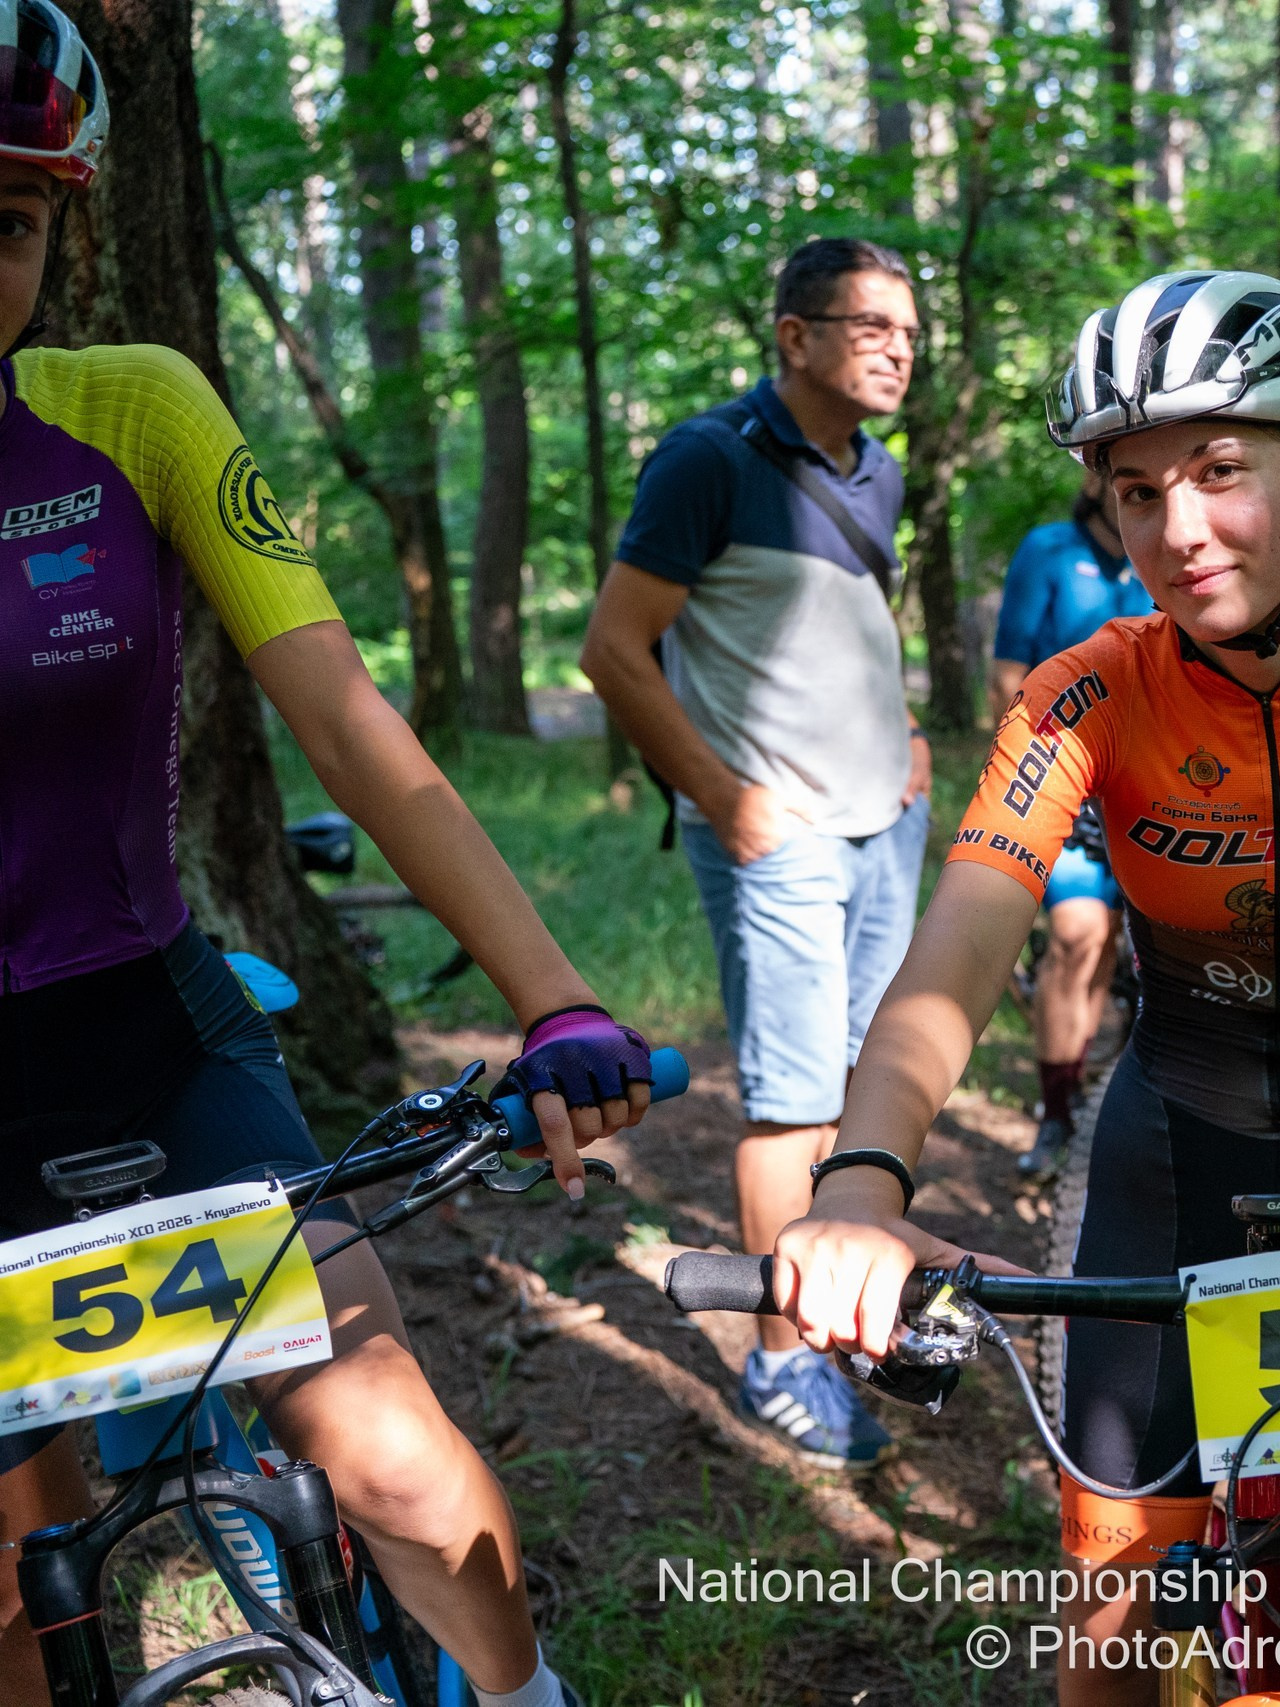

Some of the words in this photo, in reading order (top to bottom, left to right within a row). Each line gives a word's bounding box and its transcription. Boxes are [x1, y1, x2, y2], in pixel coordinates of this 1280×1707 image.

[8, 487, 96, 526] DIEM
[9, 510, 94, 539] SPORT
[49, 617, 115, 638] CENTER
[61, 608, 101, 626] BIKE
[31, 649, 85, 667] Bike
[164, 683, 183, 789] Omega
[1151, 801, 1205, 821] Горна
[1210, 810, 1259, 823] Баня
[167, 790, 180, 866] Team
[38, 1231, 126, 1265] Championship
[128, 1223, 155, 1240] XCO
[157, 1214, 193, 1232] 2026
[204, 1197, 271, 1221] Knyazhevo
[51, 1238, 248, 1355] 54
[1198, 1281, 1246, 1298] National
[1061, 1517, 1132, 1546] INGS
